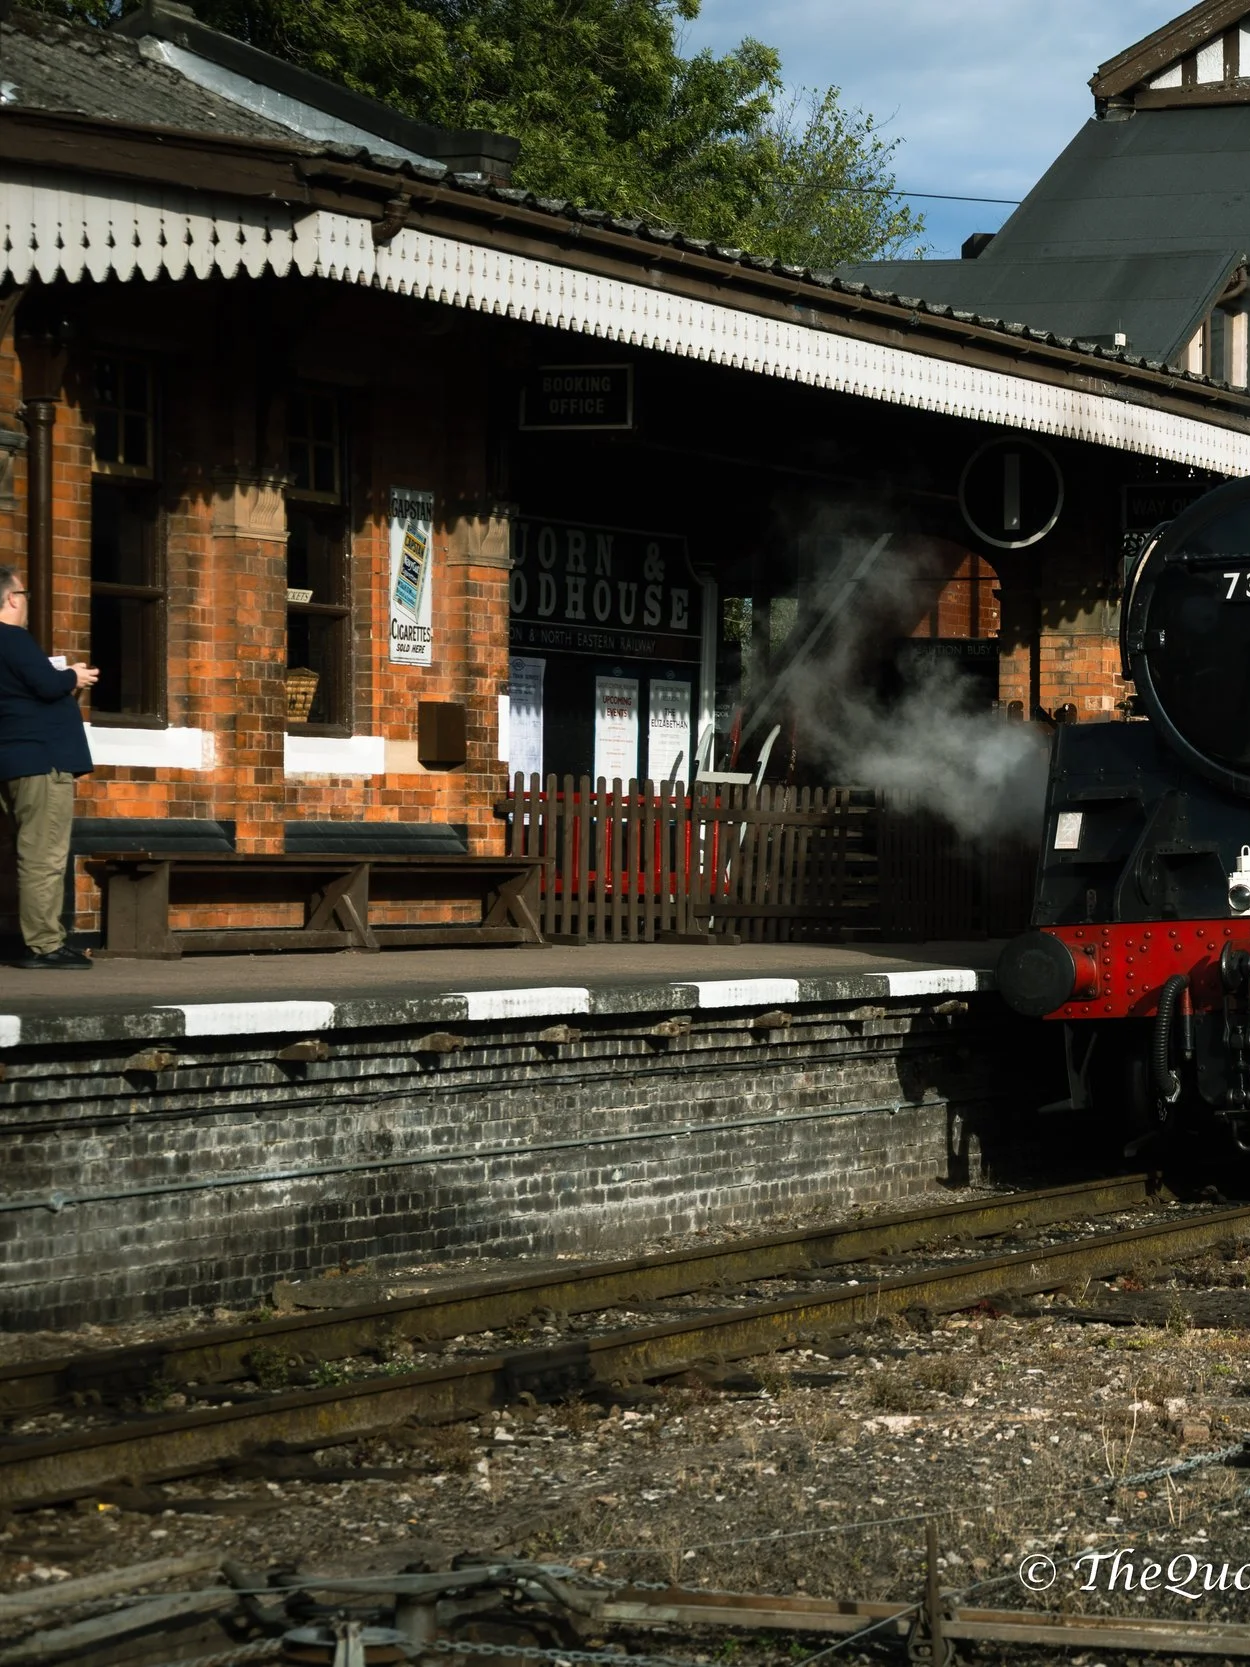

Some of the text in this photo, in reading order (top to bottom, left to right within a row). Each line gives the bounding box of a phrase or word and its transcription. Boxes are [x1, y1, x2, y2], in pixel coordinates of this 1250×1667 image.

[543, 375, 612, 393] BOOKING
[549, 396, 605, 414] OFFICE
[1132, 498, 1167, 517] WAY
[643, 541, 666, 583] &
[528, 629, 536, 642] &
[541, 629, 572, 646] NORTH
[577, 632, 615, 650] EASTERN
[620, 637, 657, 654] RAILWAY
[396, 643, 426, 655] SOLD HERE
[967, 643, 992, 656] BUSY
[602, 695, 632, 706] UPCOMING
[606, 708, 628, 718] EVENTS
[664, 707, 676, 717] THE
[651, 719, 688, 729] ELIZABETHAN
